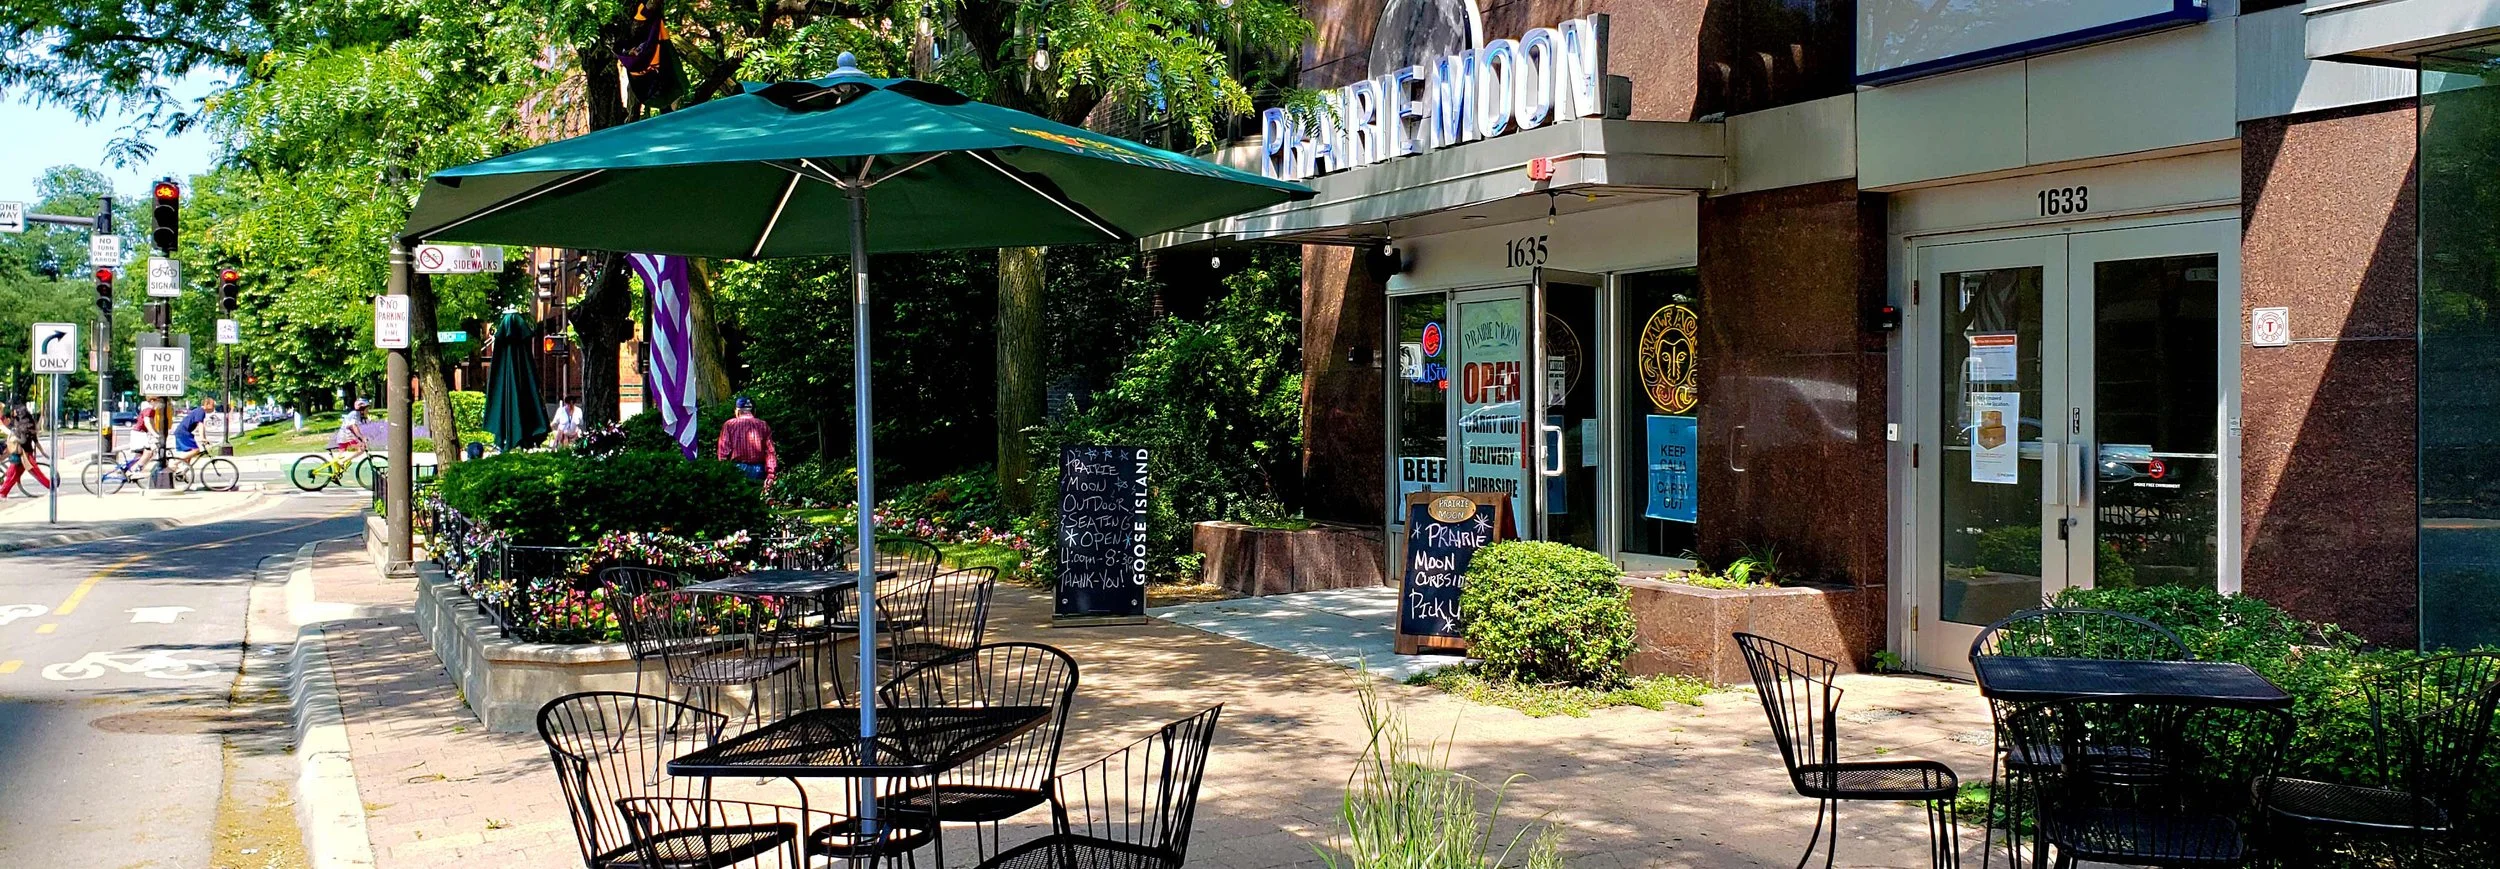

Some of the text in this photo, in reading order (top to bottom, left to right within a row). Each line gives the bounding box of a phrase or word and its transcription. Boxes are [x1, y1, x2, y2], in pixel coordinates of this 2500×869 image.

[1262, 13, 1608, 181] PRAIRIE MOON
[2038, 186, 2088, 216] 1633
[470, 249, 480, 258] ON
[1505, 235, 1548, 268] 1635
[453, 260, 498, 270] SIDEWALKS
[386, 300, 398, 309] NO
[378, 312, 406, 320] PARKING
[2266, 322, 2274, 332] T
[1464, 321, 1494, 350] PRAIRIE
[1495, 321, 1520, 347] MOON
[39, 358, 70, 368] ONLY
[153, 353, 172, 361] NO
[146, 383, 179, 391] ARROW
[1463, 361, 1520, 404] OPEN
[1465, 415, 1519, 434] CARRY OUT
[1469, 446, 1516, 466] DELIVERY
[1661, 445, 1686, 457] KEEP
[1065, 449, 1120, 476] PRAIRIE
[1660, 459, 1687, 472] CALM
[1066, 476, 1107, 492] MOON
[1467, 477, 1518, 498] CURBSIDE
[1657, 482, 1690, 495] CARRY
[1063, 494, 1130, 512] OUTDOOR
[1439, 499, 1469, 508] PRAIRIE
[1663, 497, 1683, 510] OUT
[1065, 512, 1131, 531] SEATING
[1133, 448, 1149, 586] GOOSE ISLAND
[1439, 511, 1464, 519] MOON
[1425, 523, 1487, 548] PRAIRIE
[1414, 549, 1455, 570] MOON
[1415, 571, 1465, 588] CURBSID
